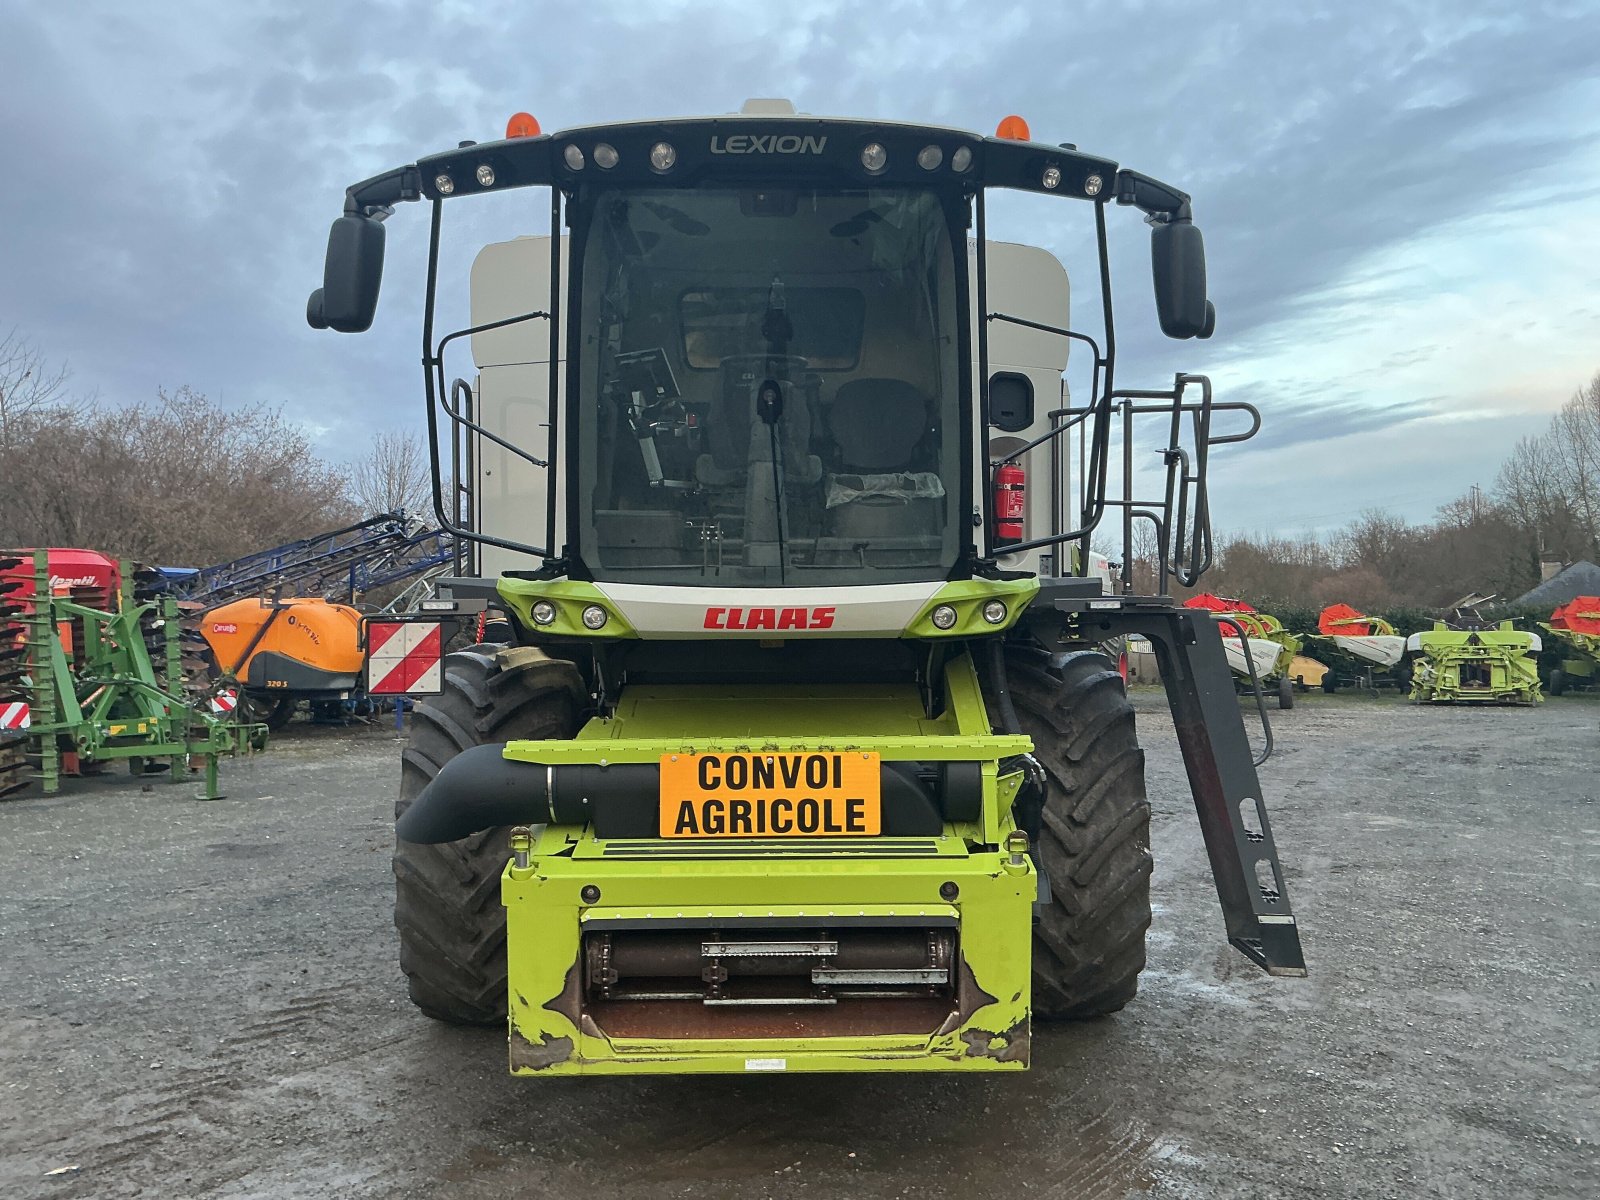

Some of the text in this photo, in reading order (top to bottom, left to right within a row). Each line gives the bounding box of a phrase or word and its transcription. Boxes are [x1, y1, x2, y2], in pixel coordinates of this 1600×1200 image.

[710, 135, 828, 154] LEXION
[703, 607, 836, 629] CLAAS
[698, 755, 842, 790] CONVOI
[674, 798, 866, 834] AGRICOLE
